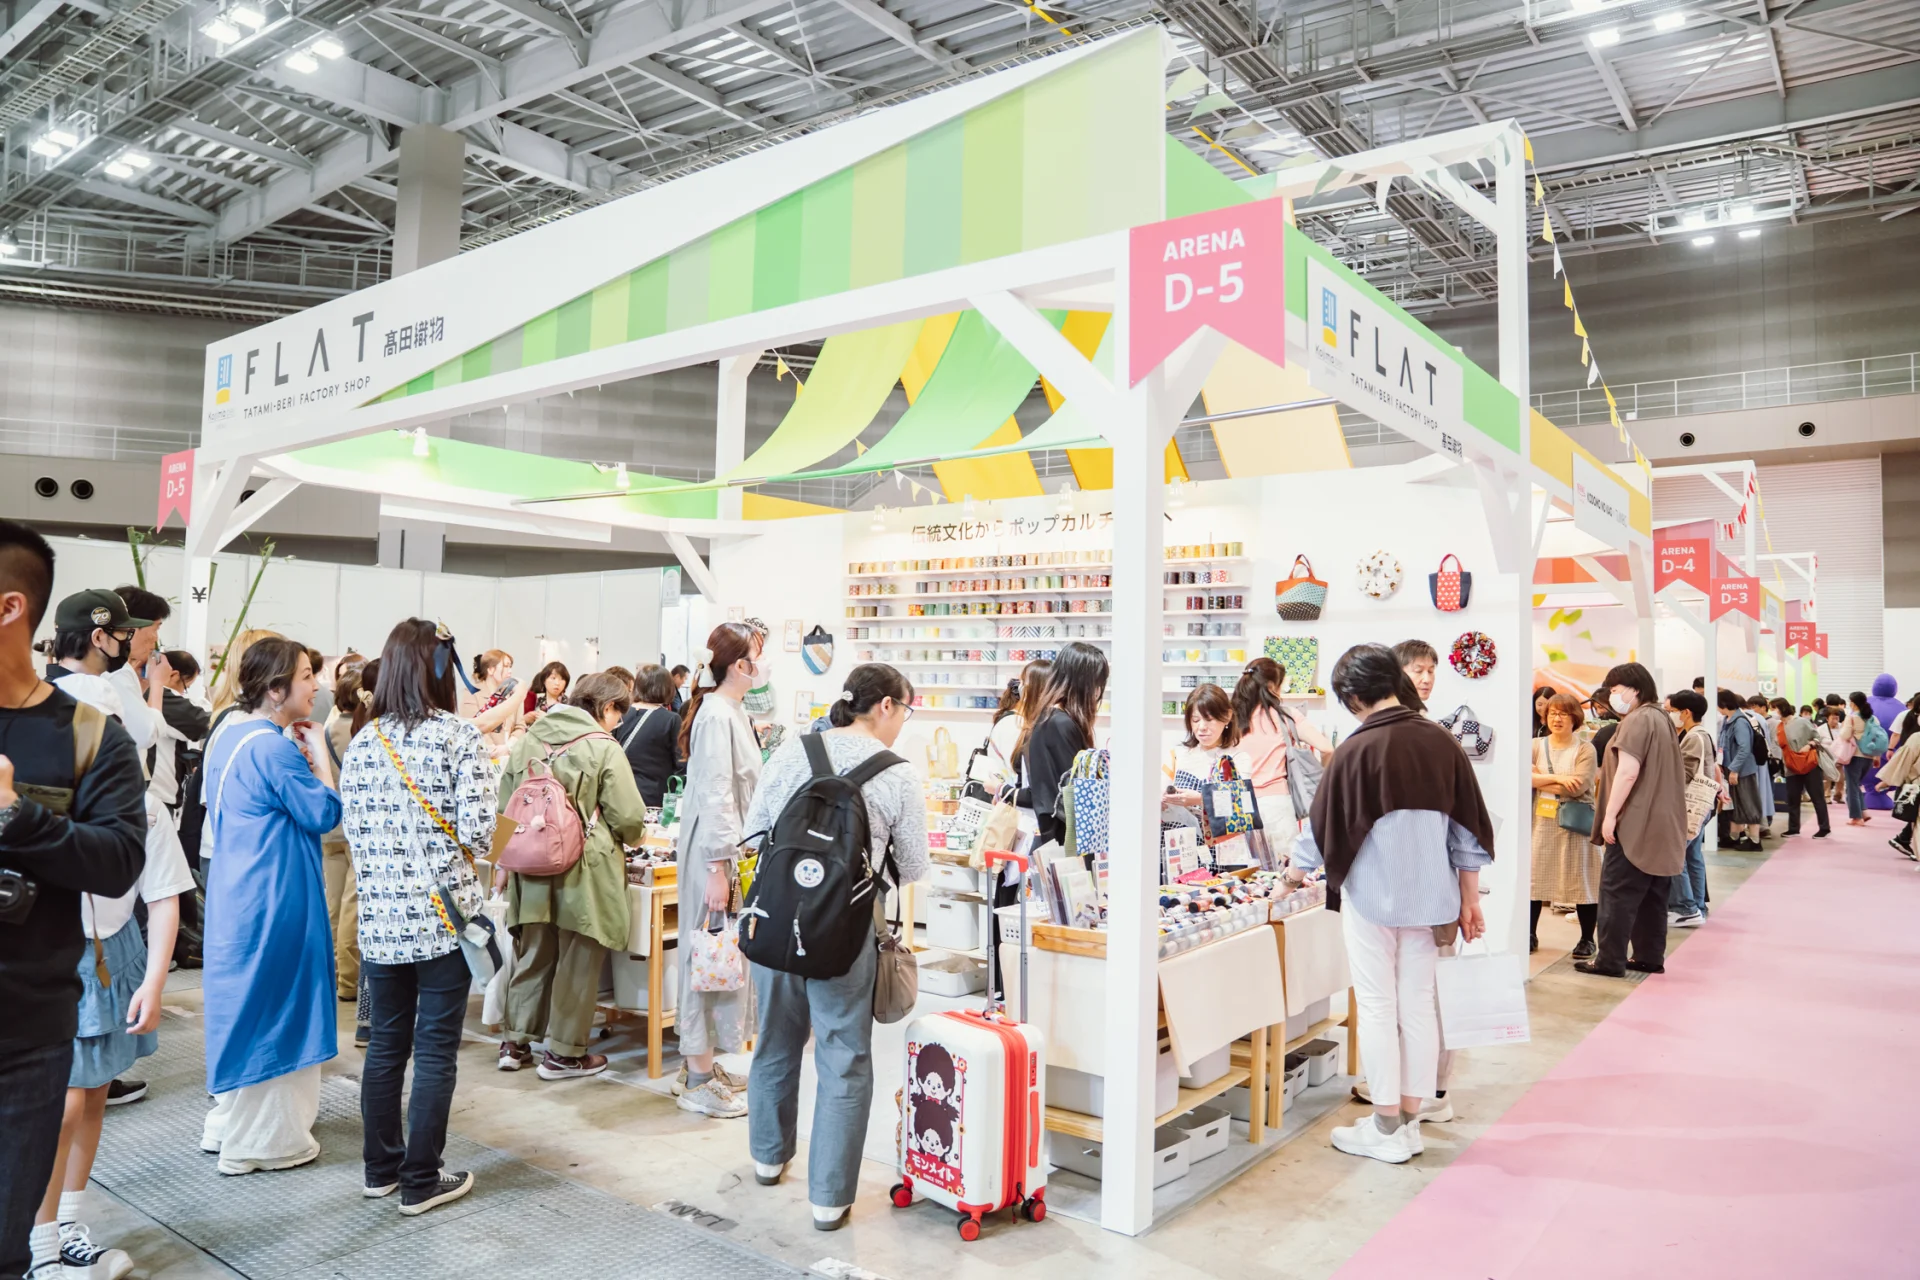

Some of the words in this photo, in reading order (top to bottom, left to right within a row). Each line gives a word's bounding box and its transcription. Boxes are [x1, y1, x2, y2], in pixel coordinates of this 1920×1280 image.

[1163, 227, 1245, 262] ARENA
[1164, 262, 1245, 313] D-5
[245, 311, 374, 395] FLAT
[1350, 309, 1437, 406] FLAT
[244, 395, 296, 419] TATAMI-BERI
[299, 384, 340, 405] FACTORY
[344, 375, 371, 394] SHOP
[1351, 372, 1394, 406] TATAMI-BERI
[1395, 398, 1422, 422] FACTORY
[1423, 415, 1438, 431] SHOP
[168, 461, 187, 474] ARENA
[166, 477, 185, 499] D-5
[1661, 546, 1695, 556] ARENA
[1661, 558, 1695, 573] D-4
[192, 586, 207, 603] ¥
[1721, 592, 1748, 604] D-3
[1789, 632, 1808, 640] D-2
[912, 1154, 955, 1182] モンメイト
